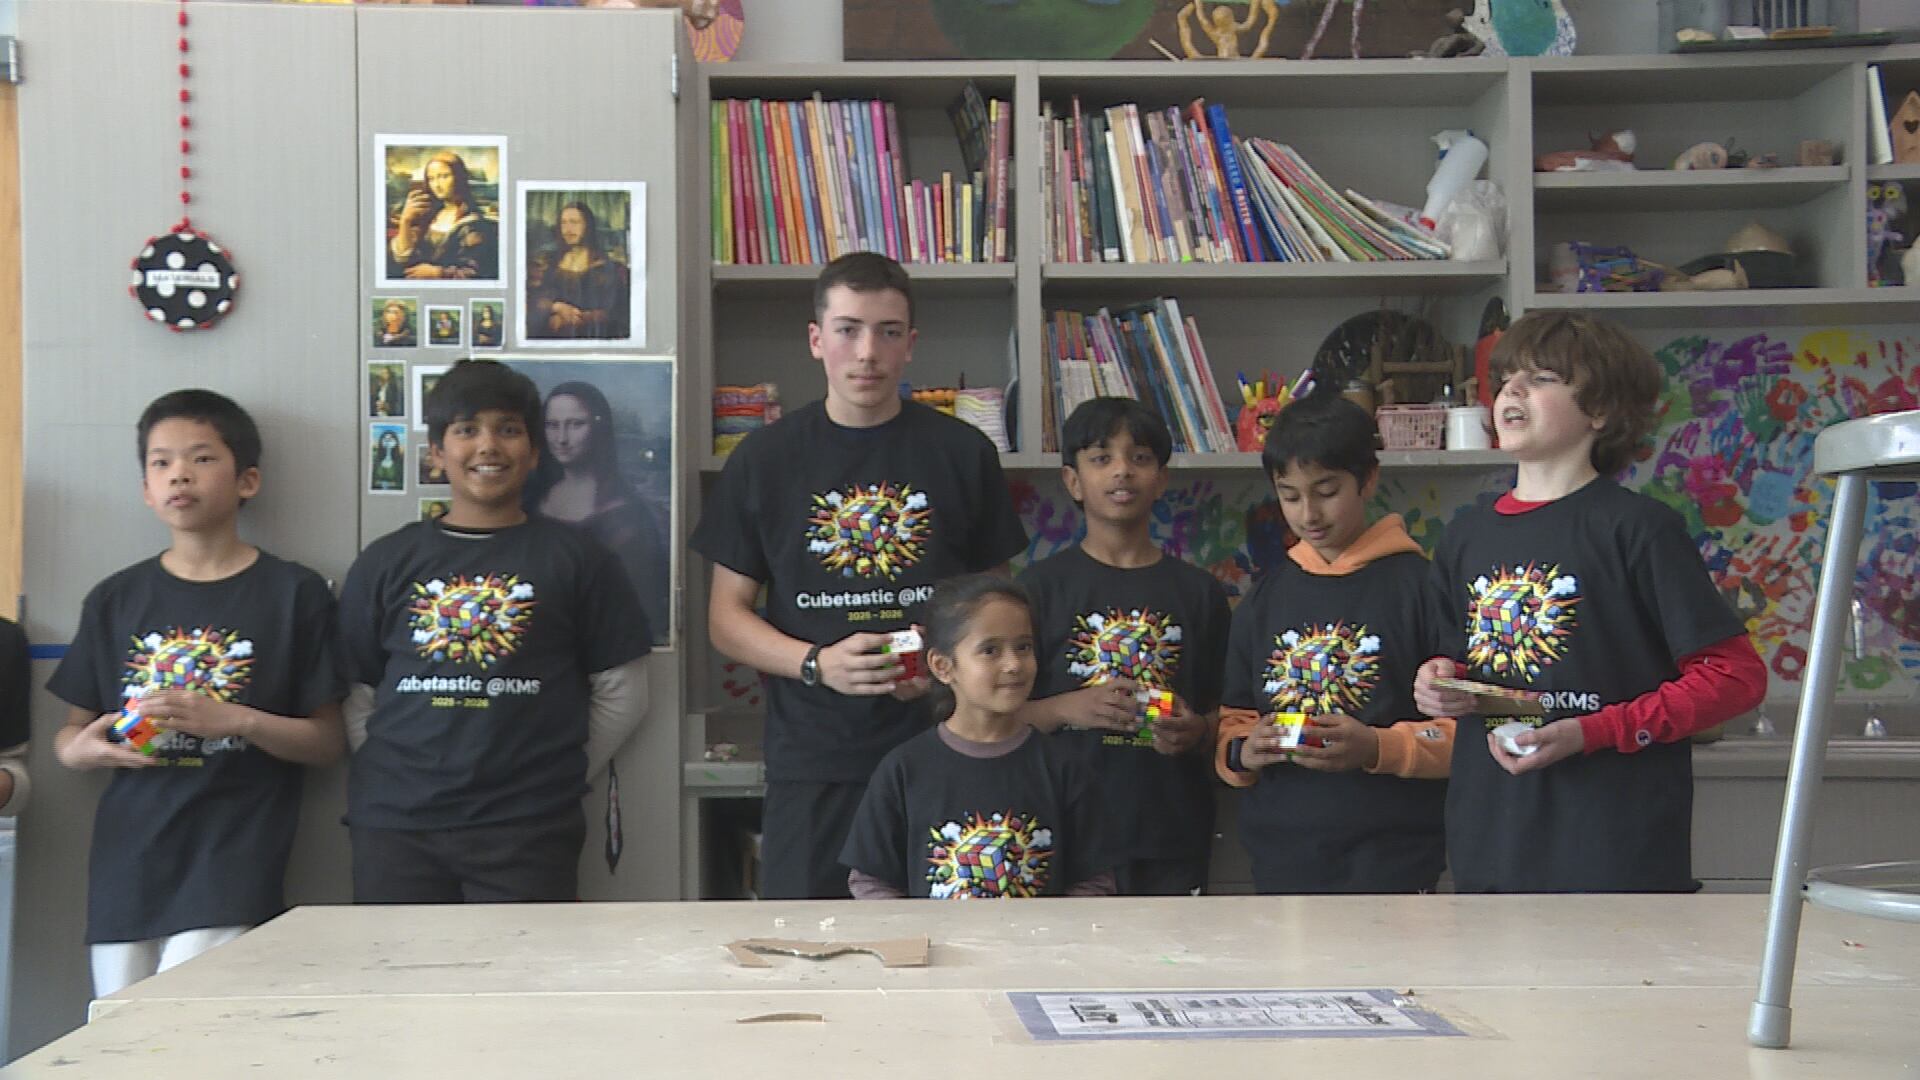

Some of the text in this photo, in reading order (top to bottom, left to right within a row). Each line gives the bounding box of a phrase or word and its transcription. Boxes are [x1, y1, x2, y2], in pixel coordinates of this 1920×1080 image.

[1236, 187, 1252, 225] BRITTO
[796, 589, 893, 608] Cubetastic
[486, 677, 541, 696] @KMS
[1538, 691, 1601, 713] @KMS
